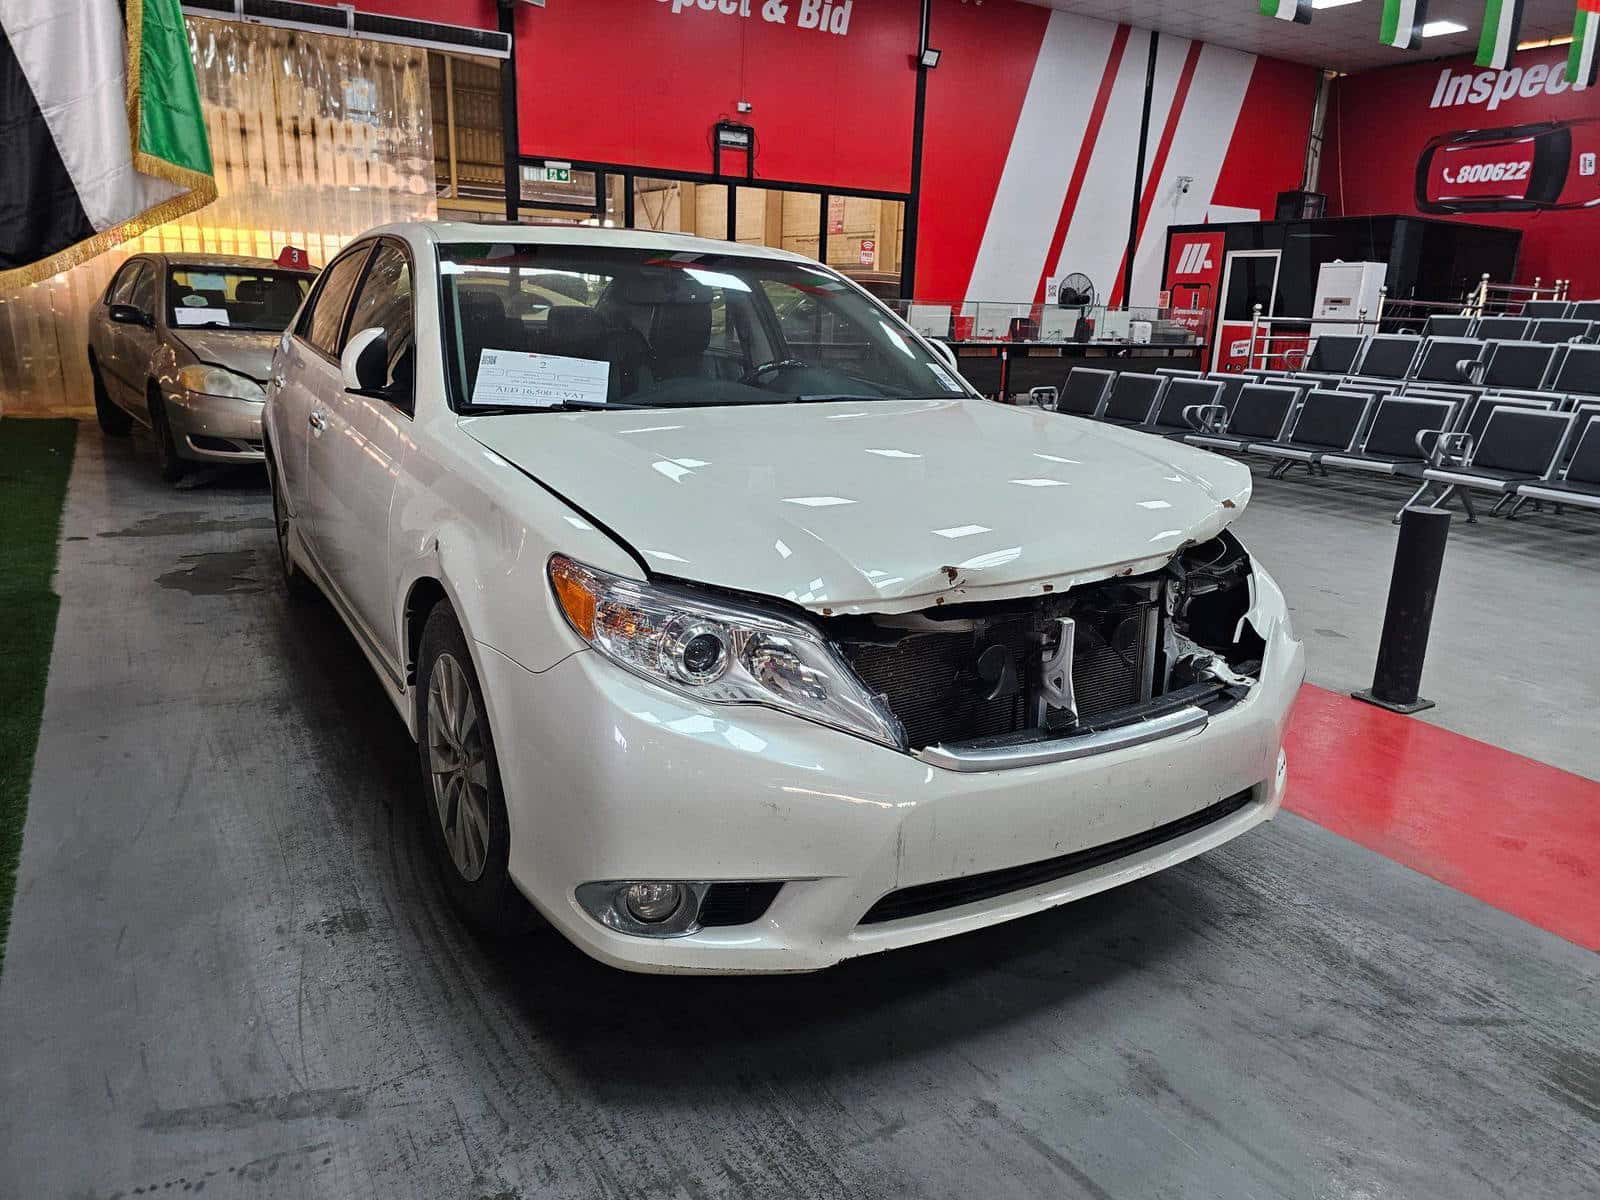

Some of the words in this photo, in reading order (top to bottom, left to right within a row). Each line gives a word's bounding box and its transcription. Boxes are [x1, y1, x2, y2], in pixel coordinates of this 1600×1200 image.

[762, 0, 788, 24] &
[797, 0, 852, 35] Bid
[1457, 161, 1530, 183] 800622
[291, 250, 299, 263] 3
[540, 361, 547, 369] 2
[495, 384, 519, 393] AED
[563, 391, 585, 399] VAT
